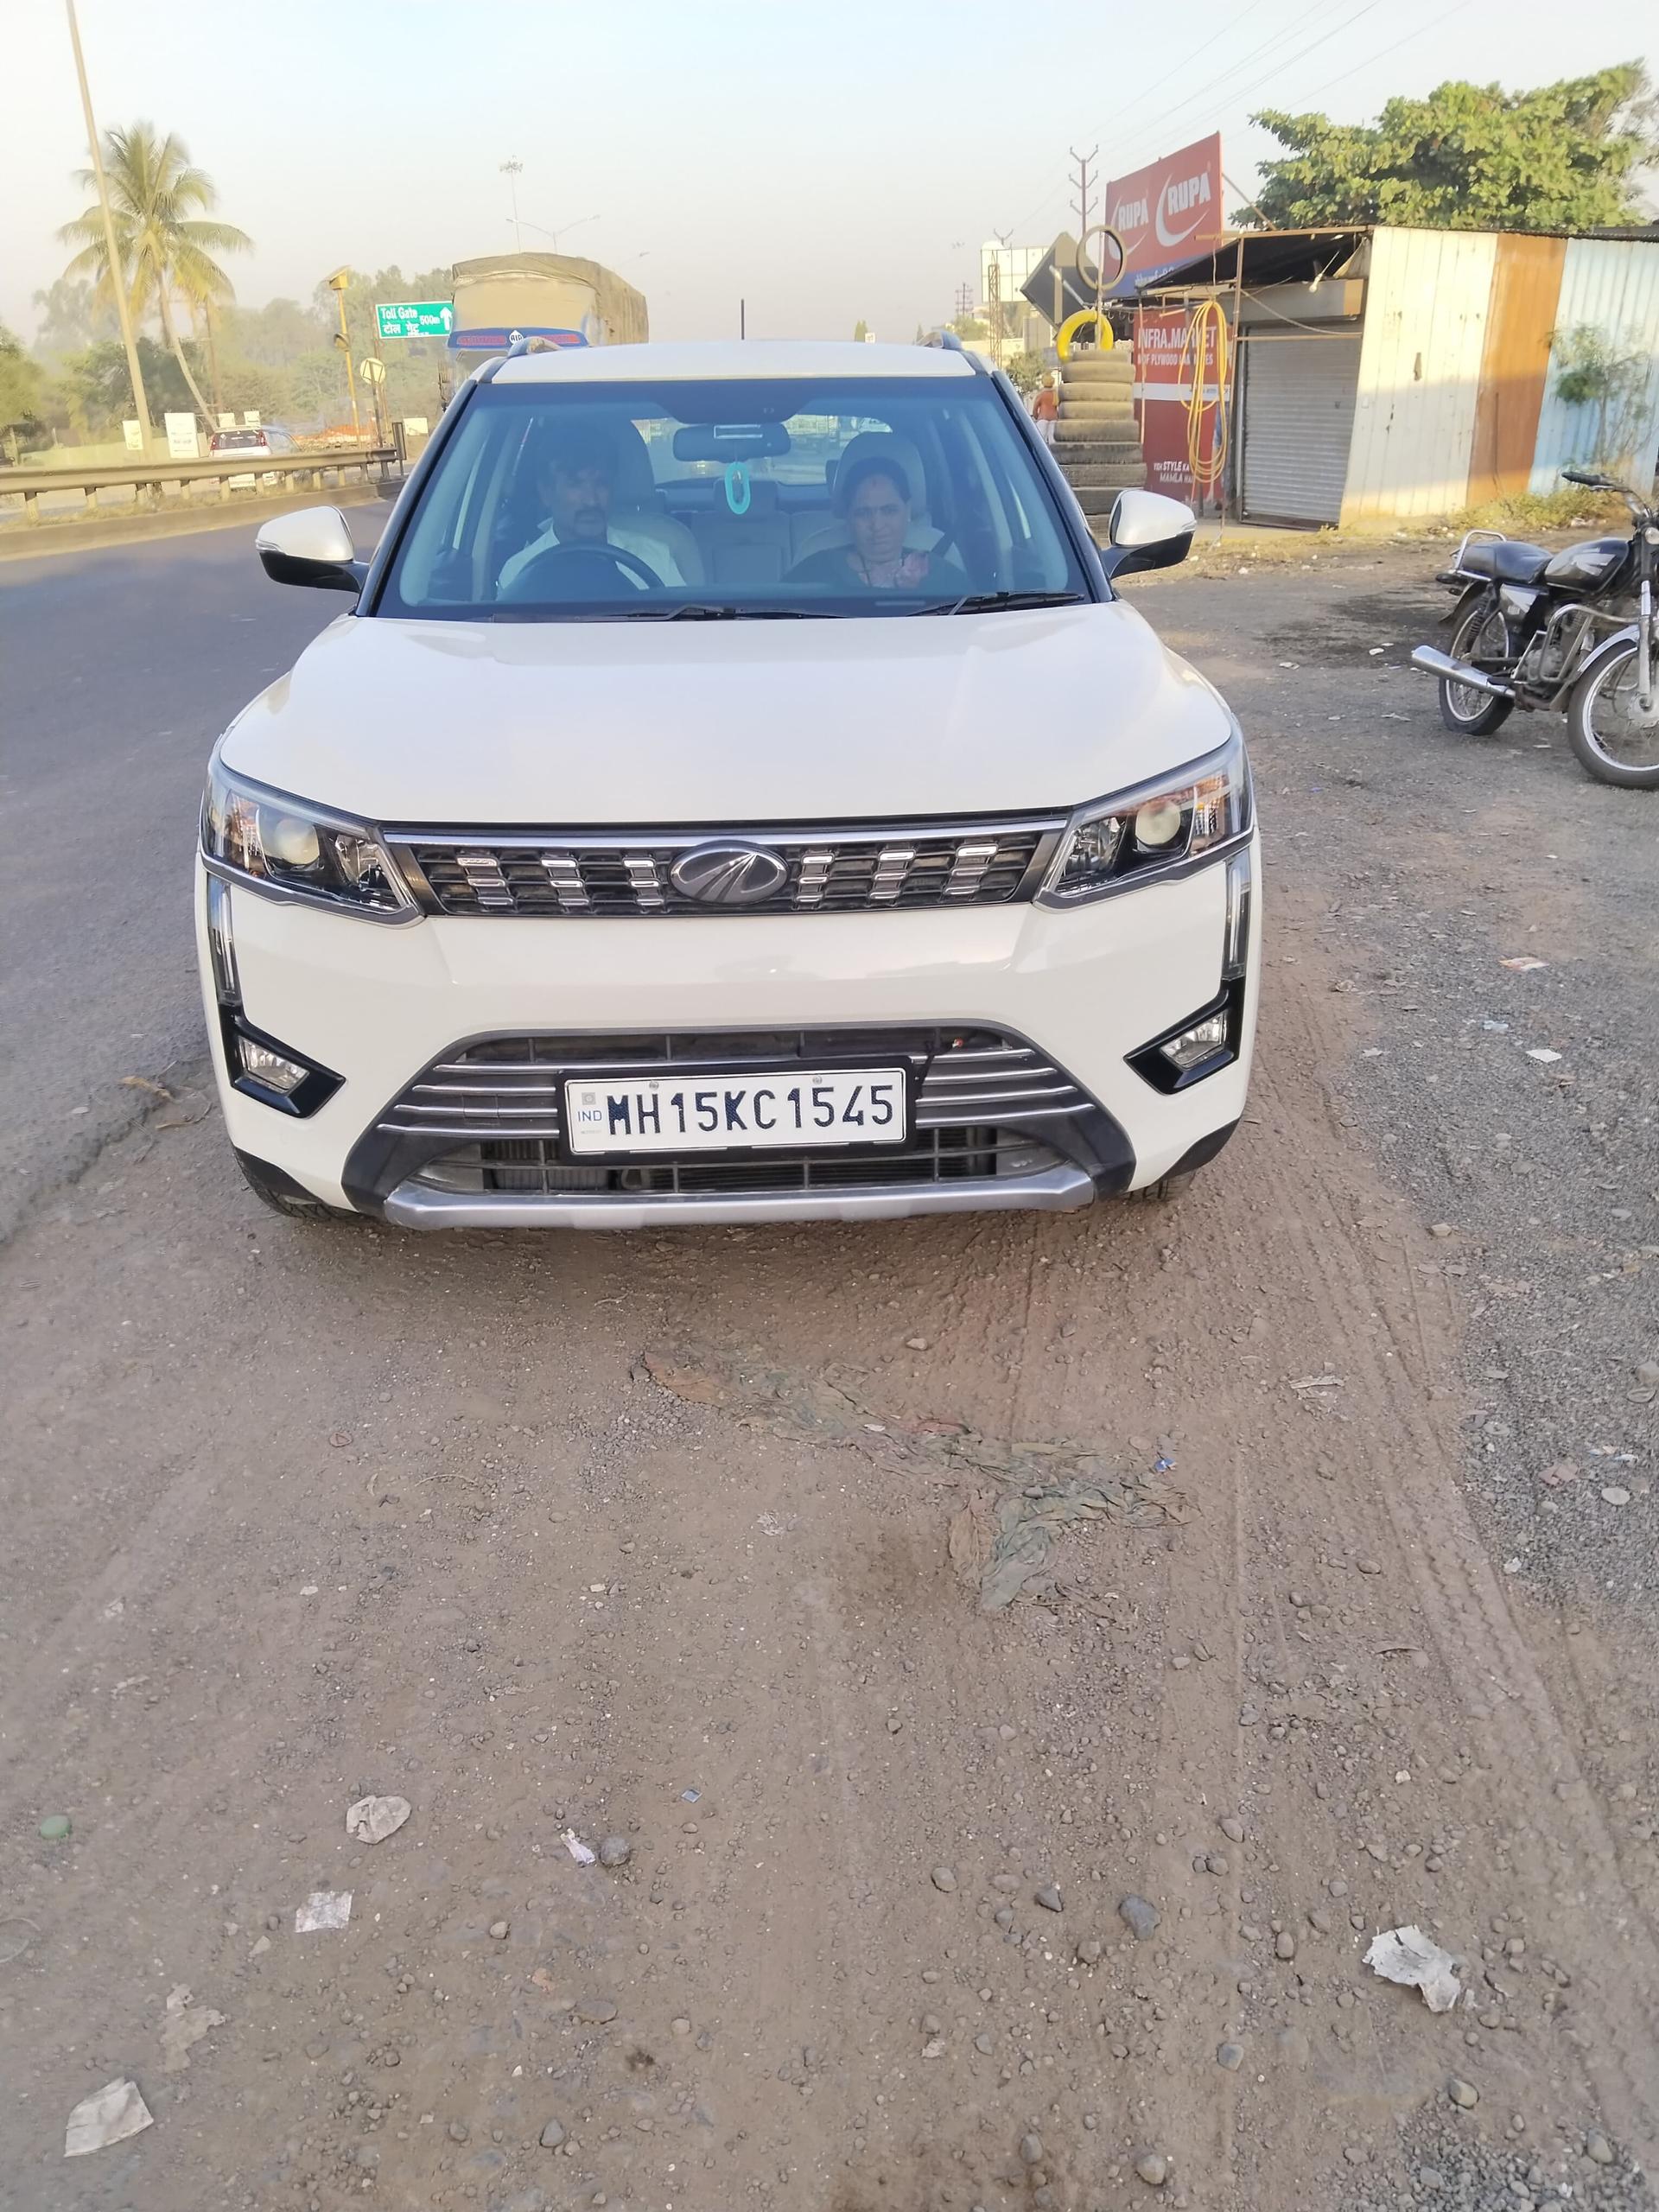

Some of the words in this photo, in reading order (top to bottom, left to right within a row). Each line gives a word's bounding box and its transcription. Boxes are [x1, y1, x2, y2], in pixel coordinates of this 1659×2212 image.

[1168, 172, 1211, 216] RUPA
[1118, 198, 1149, 232] RUPA
[380, 307, 397, 320] Toll
[397, 306, 418, 320] Gate
[419, 315, 441, 326] 500m
[1163, 461, 1182, 472] STYLE
[1160, 472, 1183, 483] MAMLA
[577, 1109, 602, 1122] IND
[607, 1084, 893, 1135] MH15KC1545
